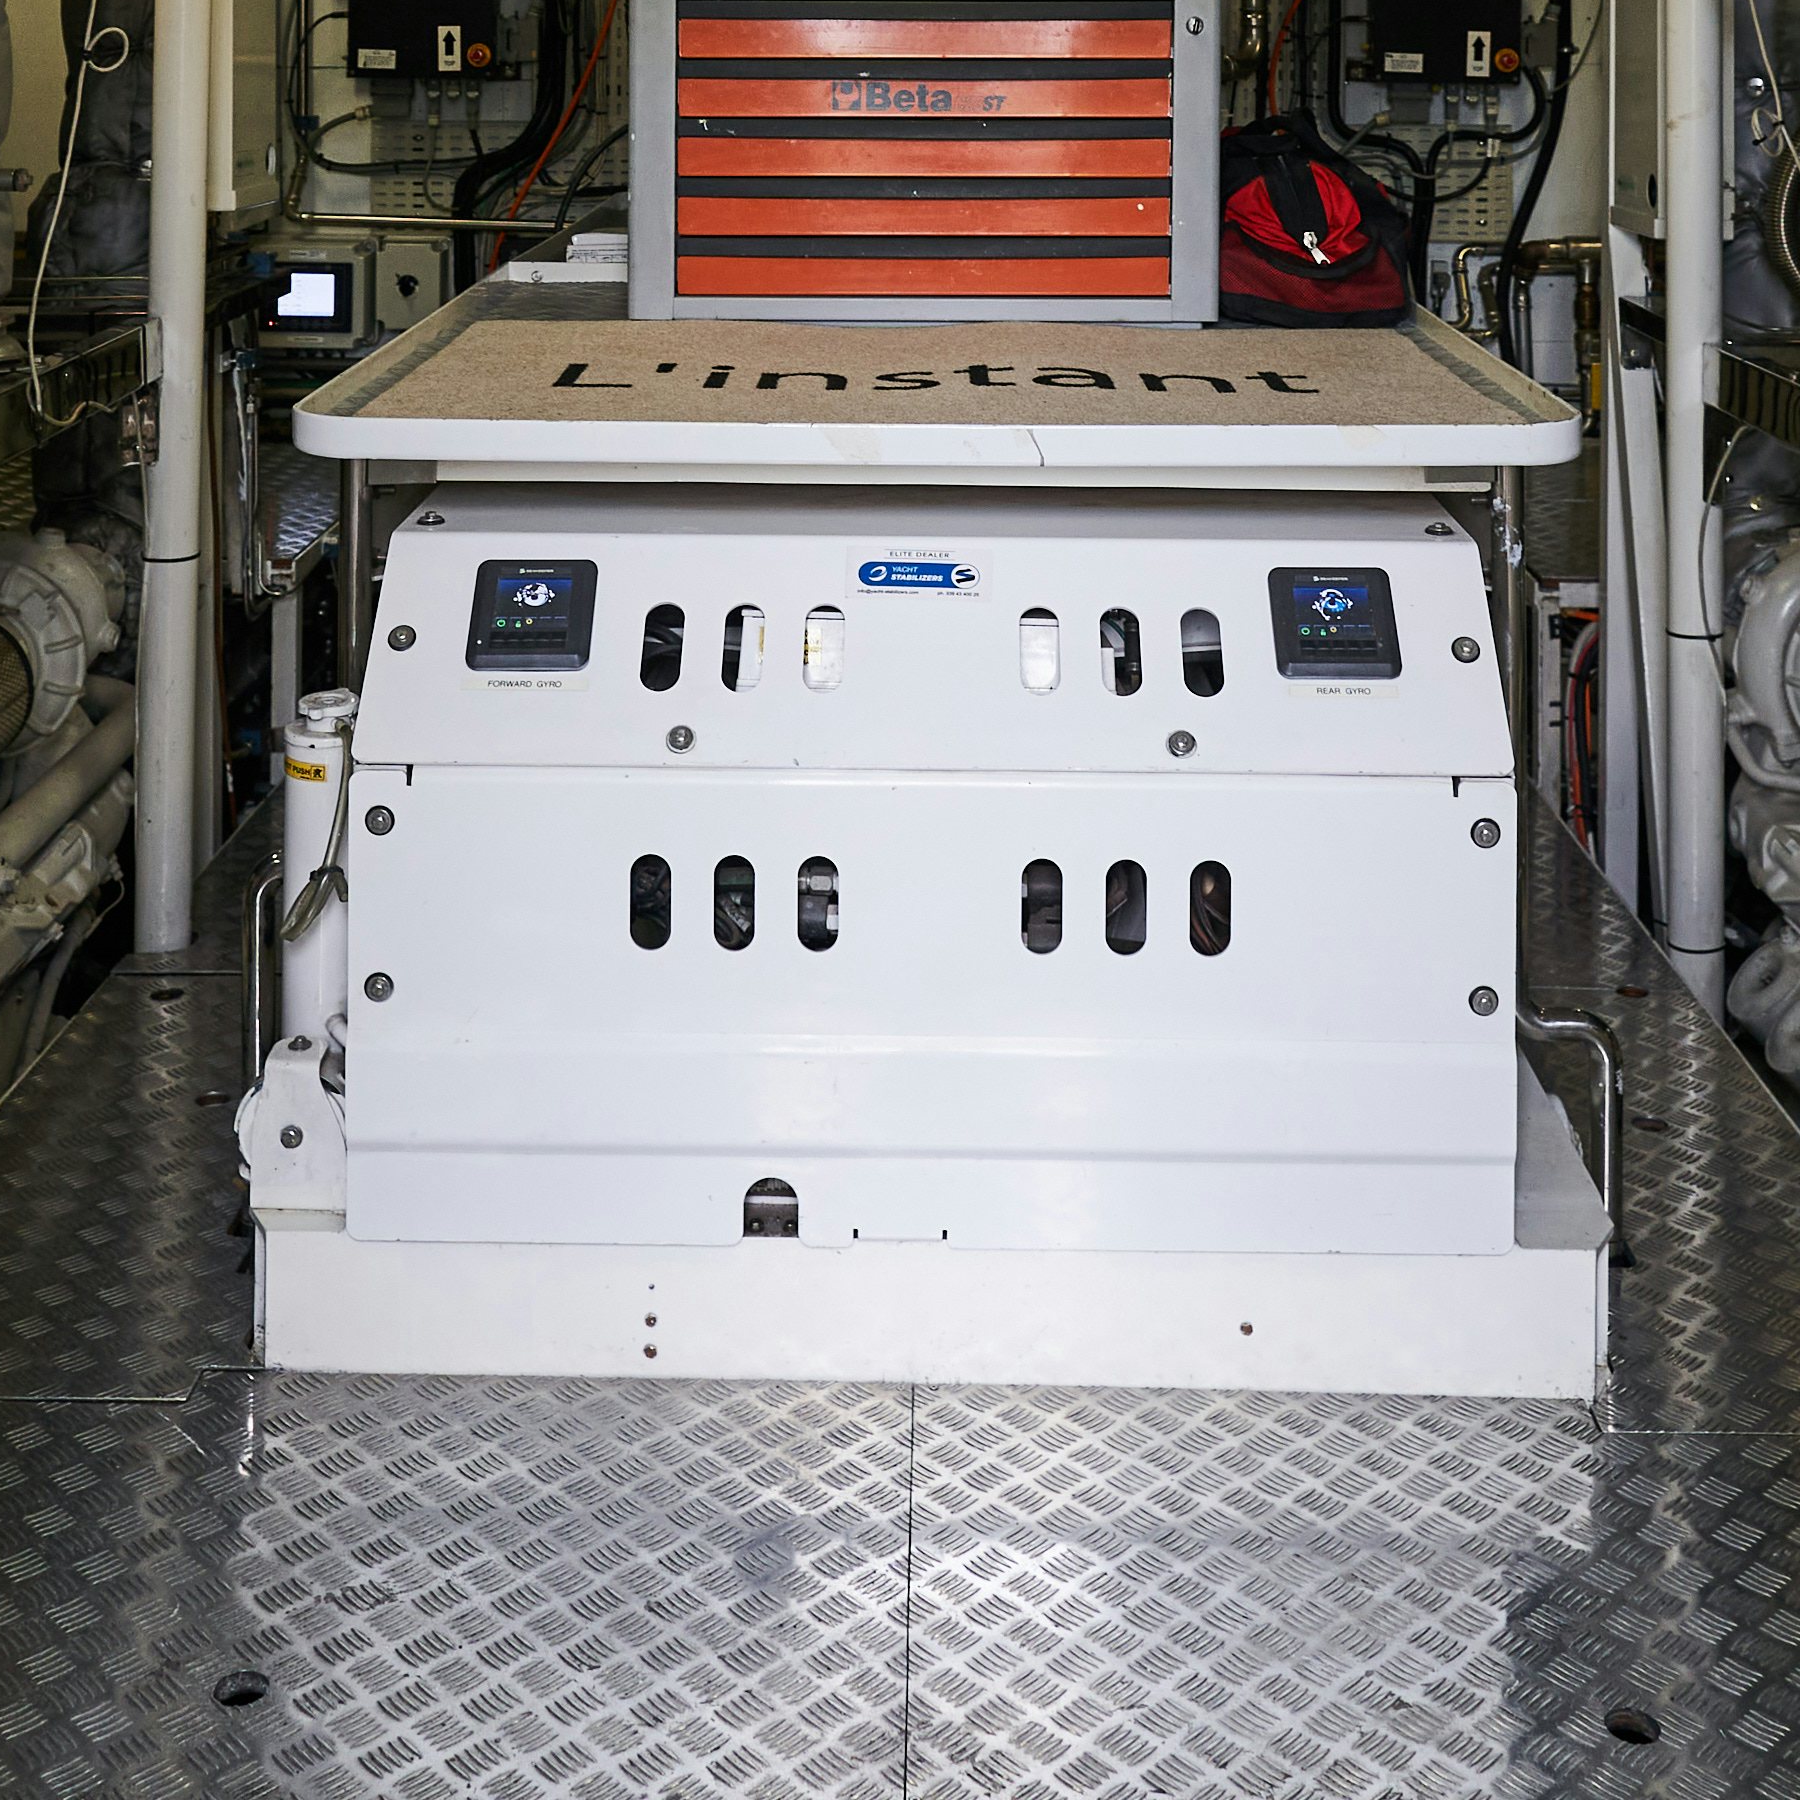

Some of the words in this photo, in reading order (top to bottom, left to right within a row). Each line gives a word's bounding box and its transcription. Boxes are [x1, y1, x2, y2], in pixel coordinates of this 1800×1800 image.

[865, 81, 953, 112] Beta
[551, 362, 1320, 394] L'instant
[890, 573, 944, 582] STABILIZERS
[487, 680, 532, 688] FORWARD
[536, 680, 562, 688] GYRO
[1316, 687, 1341, 695] REAR
[1345, 687, 1372, 695] GYRO
[292, 764, 311, 776] PUSH
